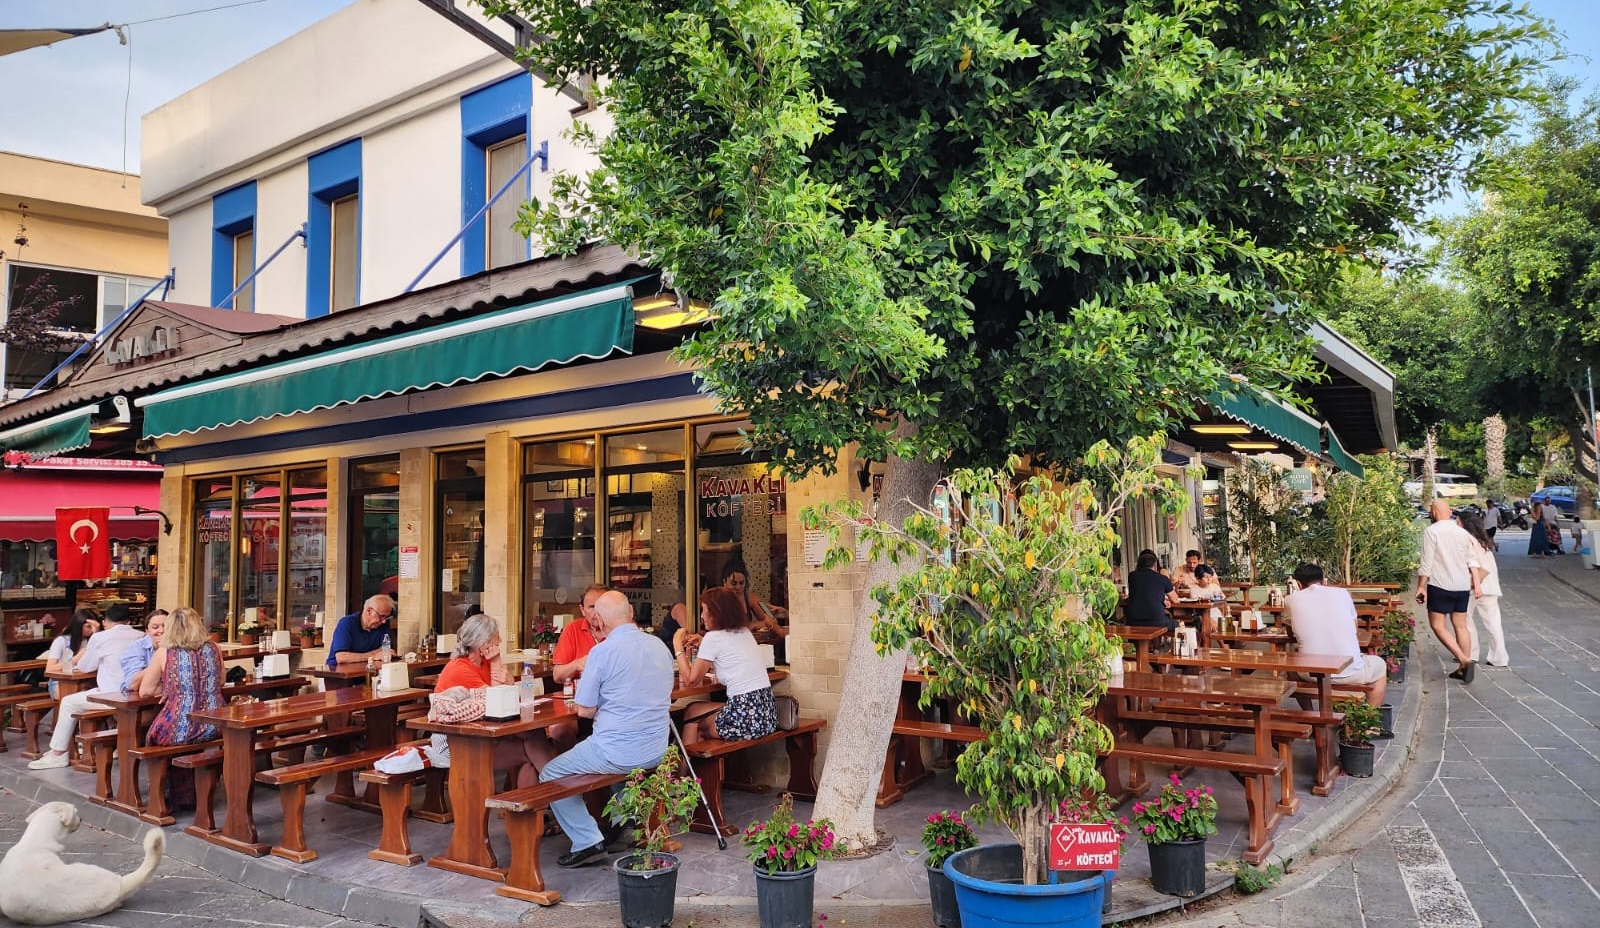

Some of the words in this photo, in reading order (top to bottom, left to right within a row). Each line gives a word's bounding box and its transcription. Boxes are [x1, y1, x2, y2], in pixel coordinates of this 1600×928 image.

[701, 474, 786, 498] KAVAKLI
[706, 497, 781, 518] KÖFTECİ
[1078, 830, 1117, 844] KAVAKLI
[1076, 851, 1112, 866] KÖFTECİ
